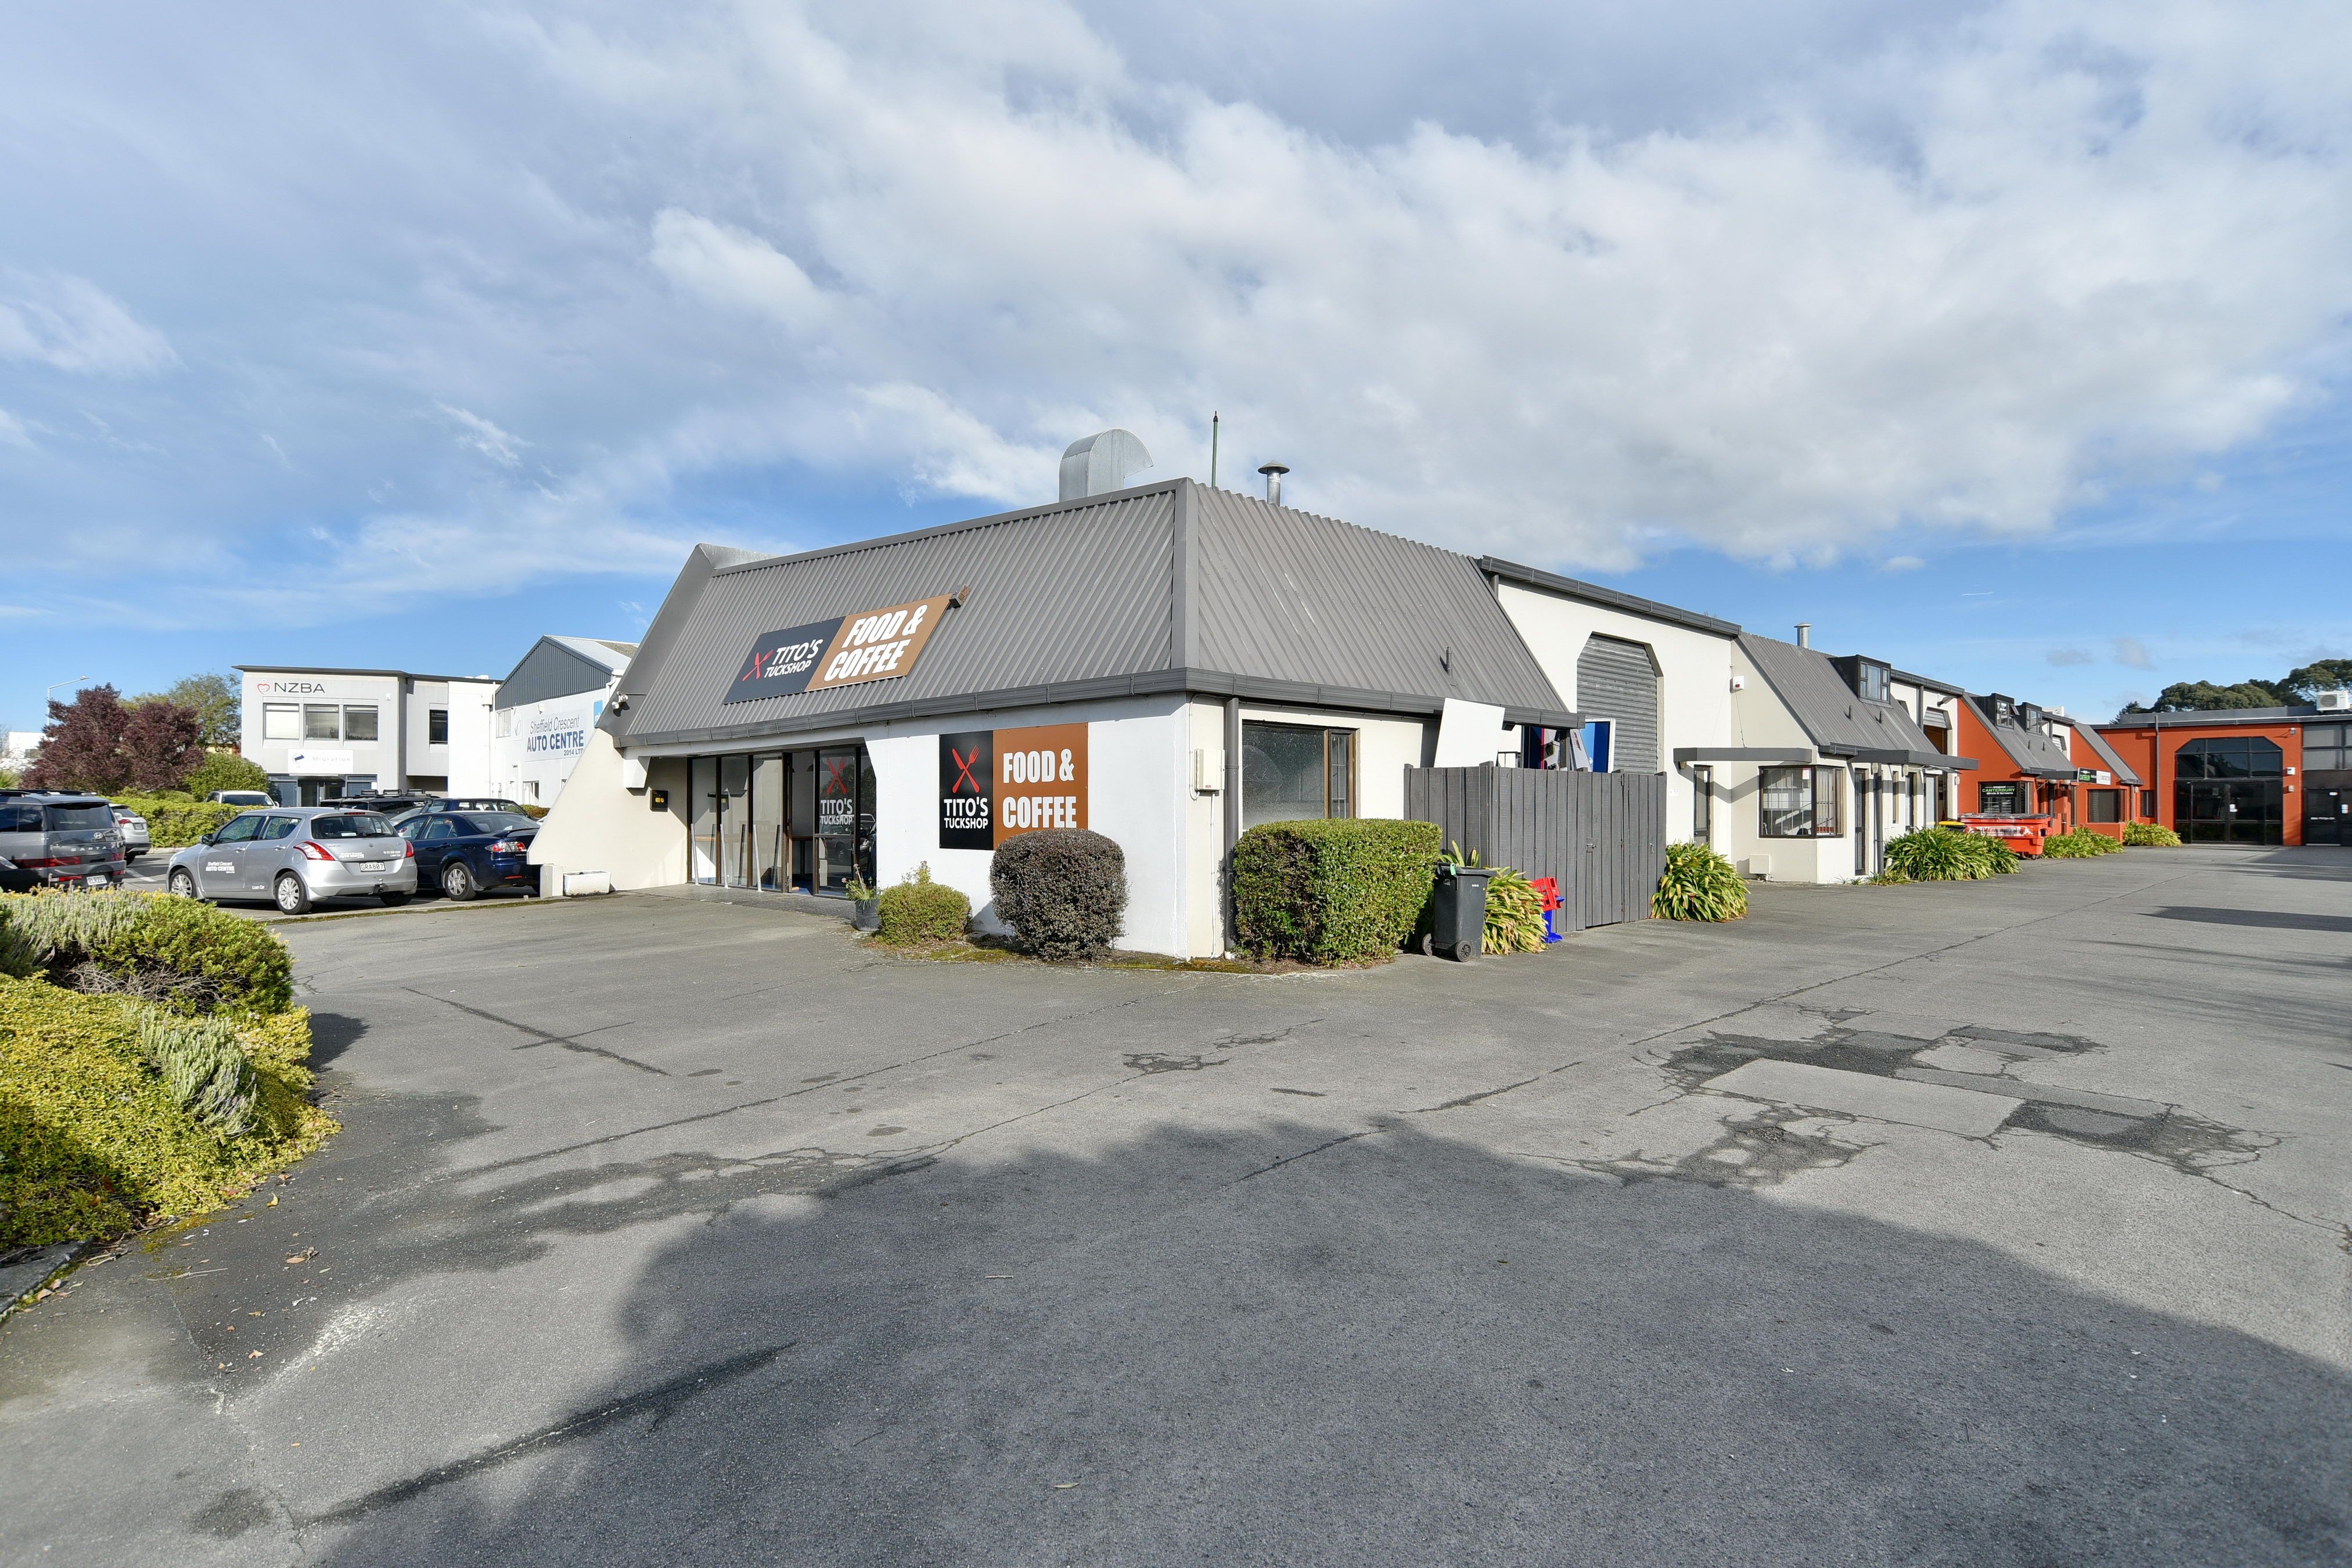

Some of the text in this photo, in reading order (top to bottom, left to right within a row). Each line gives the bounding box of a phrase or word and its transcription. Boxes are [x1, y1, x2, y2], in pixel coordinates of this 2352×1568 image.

[841, 604, 928, 649] FOOD &
[772, 639, 823, 666] TITO'S
[823, 638, 912, 682] COFFEE
[764, 660, 812, 678] TUCKSHOP
[274, 682, 325, 693] NZBA
[530, 714, 580, 734] Sheffield Crescent
[527, 730, 584, 753] AUTO CENTRE
[1003, 749, 1074, 783] FOOD &
[820, 798, 853, 814] TITO'S
[944, 796, 988, 817] TITO'S
[1002, 796, 1077, 829] COFFEE
[819, 815, 853, 825] TUCKSHOP
[944, 818, 988, 829] TUCKSHOP
